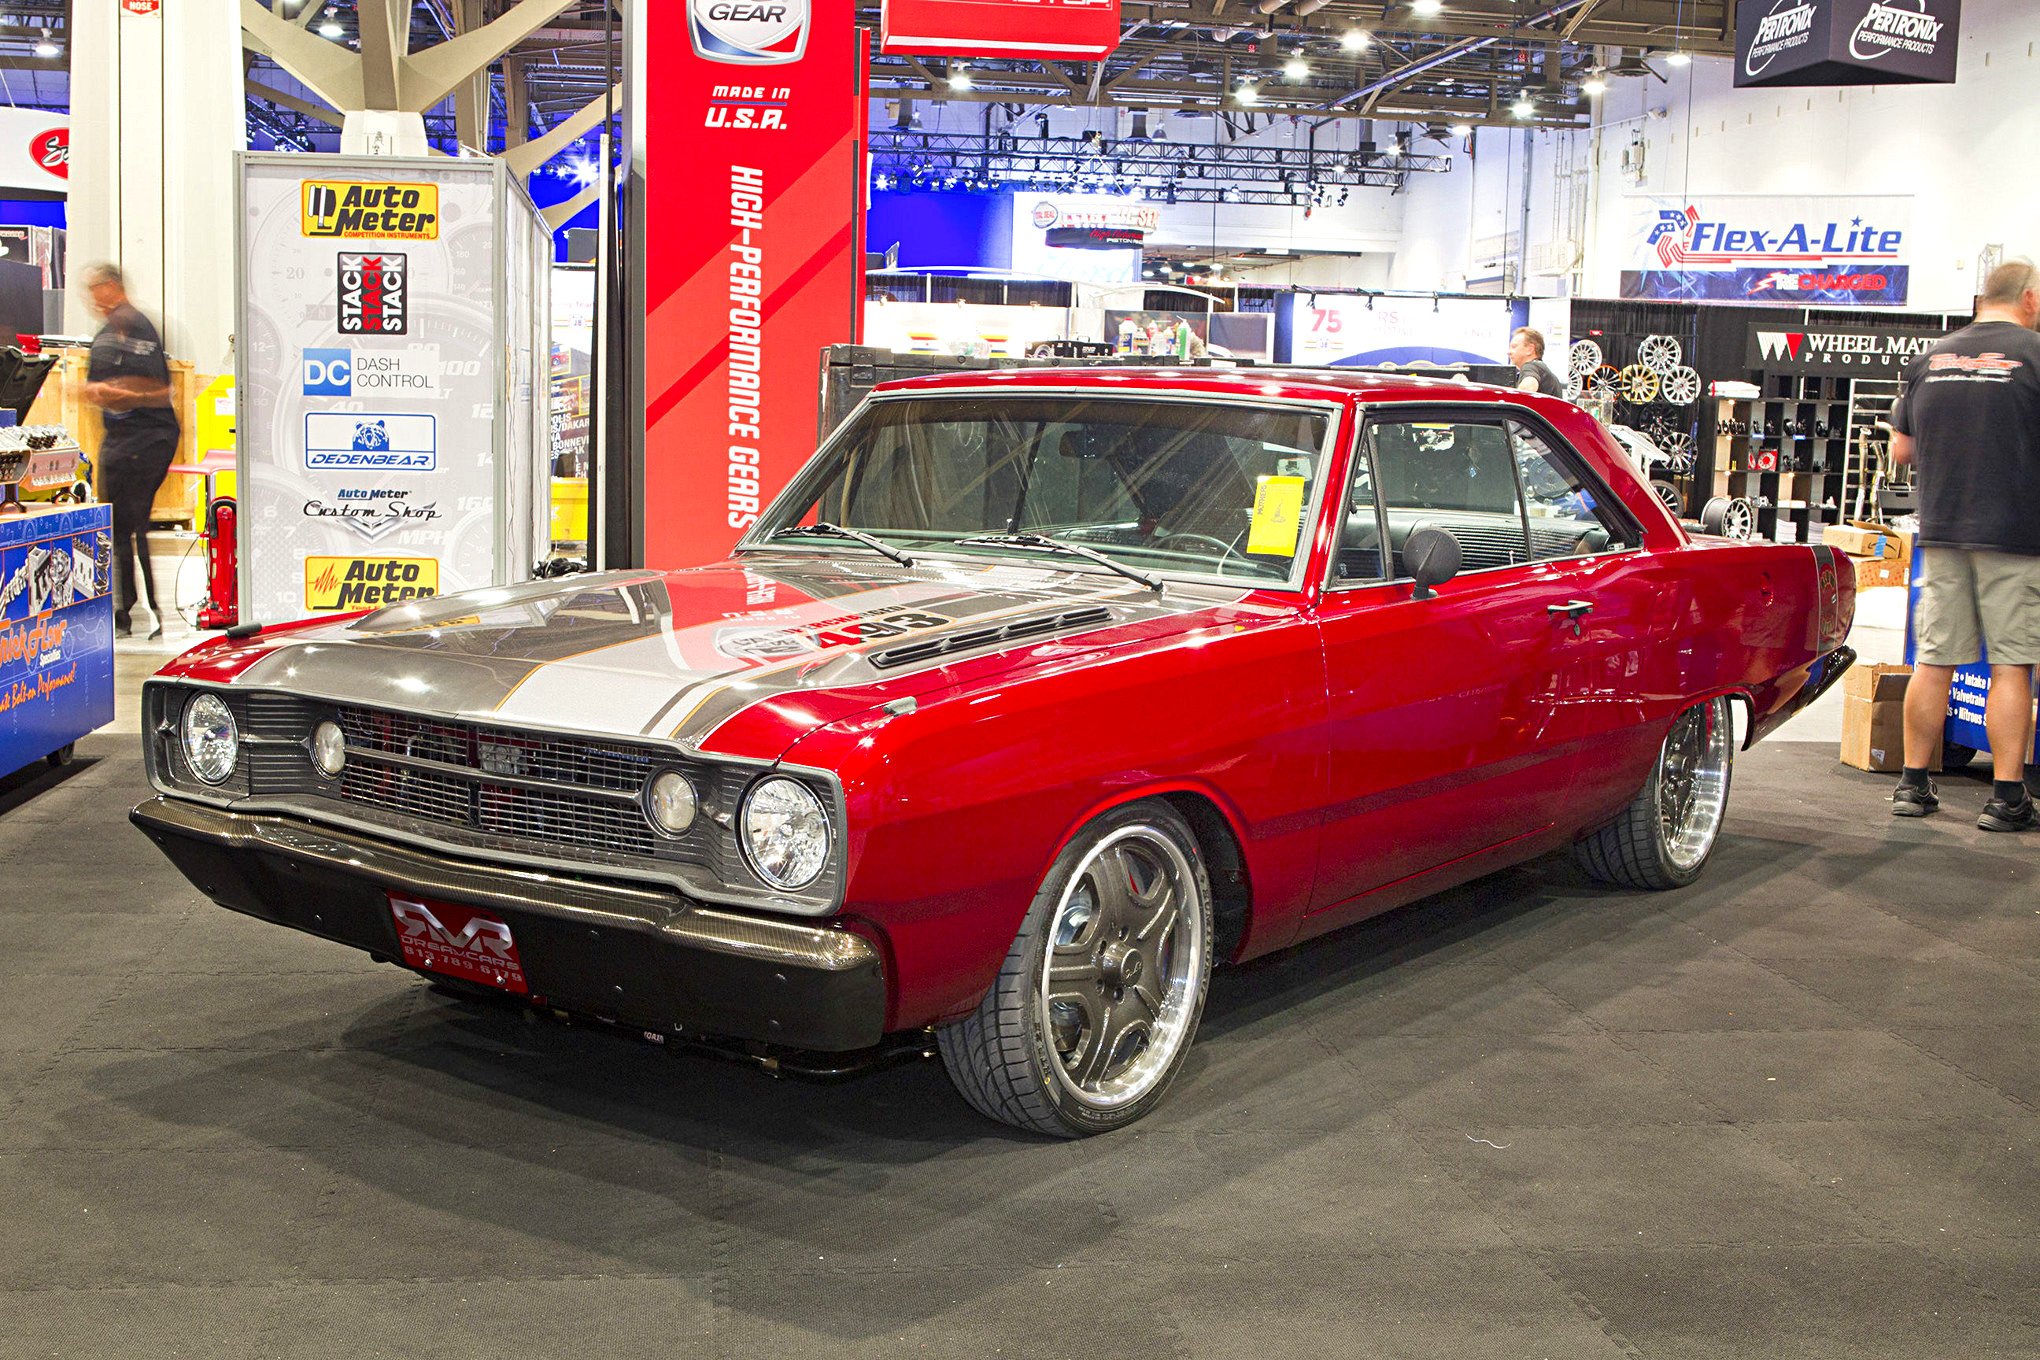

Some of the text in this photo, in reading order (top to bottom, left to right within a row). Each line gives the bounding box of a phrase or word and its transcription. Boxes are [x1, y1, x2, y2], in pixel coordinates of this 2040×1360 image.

[129, 1, 152, 11] HOSE
[708, 3, 786, 23] GEAR
[1752, 32, 1810, 59] PERFORMANCE PRODUCTS
[1857, 31, 1935, 55] PERFORMANCE PRODUCTS
[711, 85, 791, 100] MADE IN
[704, 107, 788, 130] U.S.A.
[341, 185, 420, 209] Auto
[332, 208, 436, 236] Meter
[343, 231, 431, 240] COMPETITION INSTRUMENTS
[1690, 219, 1902, 253] Flex-A-Lite
[1776, 273, 1887, 291] RECHARGED
[342, 256, 362, 331] STACK
[362, 256, 382, 331] STACK
[382, 256, 402, 331] STACK
[1311, 309, 1343, 333] 75
[727, 165, 763, 529] HIGH-PERFORMANCE GEARS
[1806, 333, 1938, 355] WHEEL MAT
[357, 357, 400, 371] DASH
[1805, 353, 1910, 367] PRODUC
[304, 359, 351, 386] DC
[356, 374, 434, 388] CONTROL
[310, 453, 430, 466] DEDENBEAR
[337, 488, 409, 501] Auto Meter
[303, 500, 442, 521] Custom Shop
[344, 560, 420, 582] Auto
[332, 582, 436, 606] Meter
[806, 613, 950, 649] 493
[1964, 672, 1987, 690] Intake
[1952, 687, 1986, 708] Valvetrain
[1958, 706, 1983, 726] Nitrous
